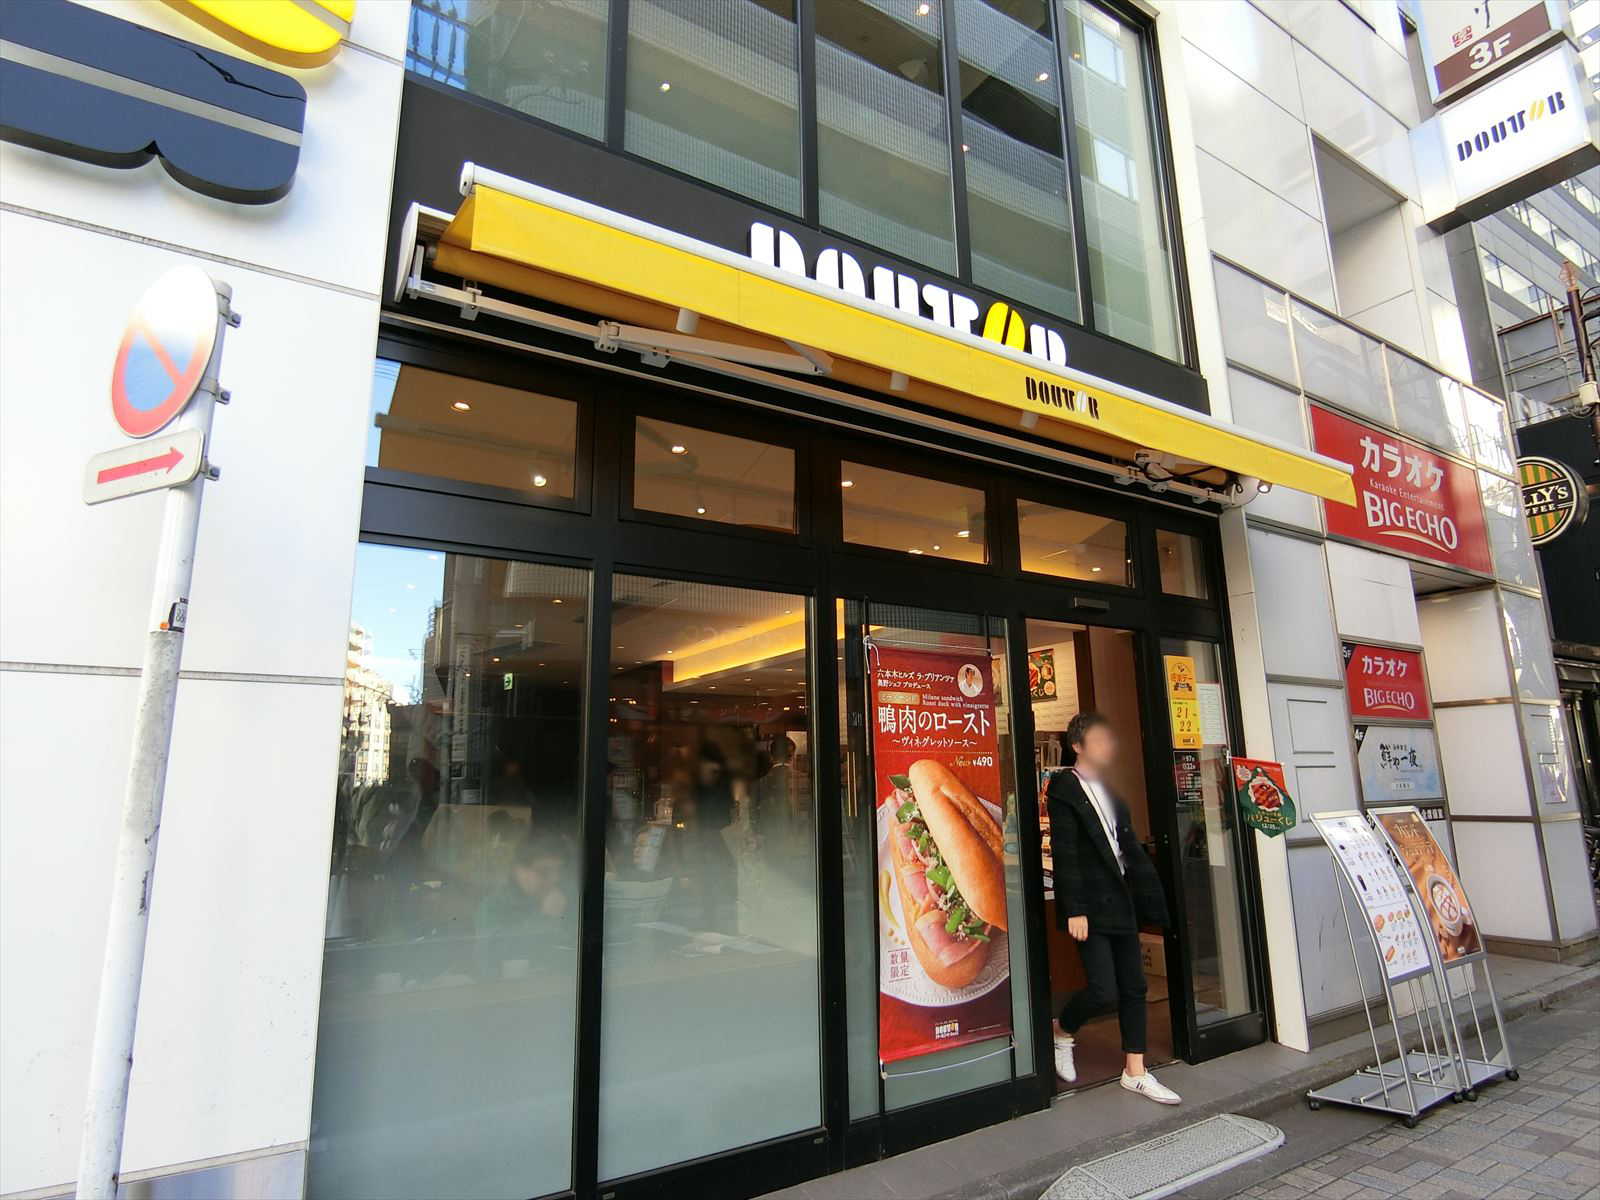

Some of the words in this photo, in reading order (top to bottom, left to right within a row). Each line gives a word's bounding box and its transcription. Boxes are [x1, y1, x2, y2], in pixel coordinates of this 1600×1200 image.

[1469, 32, 1511, 70] 3F
[1457, 91, 1566, 162] DOUTOR
[1025, 376, 1100, 420] DOUTOR
[1360, 436, 1444, 492] カラオケ
[1369, 477, 1398, 496] Karaoke
[1398, 487, 1445, 512] Entertainment
[1363, 490, 1405, 528] BIG
[1406, 505, 1458, 550] ECHO
[877, 668, 915, 681] 六本木ヒルズ
[1362, 655, 1408, 678] カラオケ
[903, 681, 932, 690] プロデュース
[922, 693, 940, 701] Milano
[941, 694, 963, 702] sandwich
[922, 699, 937, 707] Roast
[1363, 687, 1385, 708] BIG
[1385, 690, 1415, 709] ECHO
[878, 704, 990, 737] 鴨肉のロースト
[972, 756, 993, 767] ¥490
[890, 951, 909, 964] 数量
[890, 965, 910, 978] 限定
